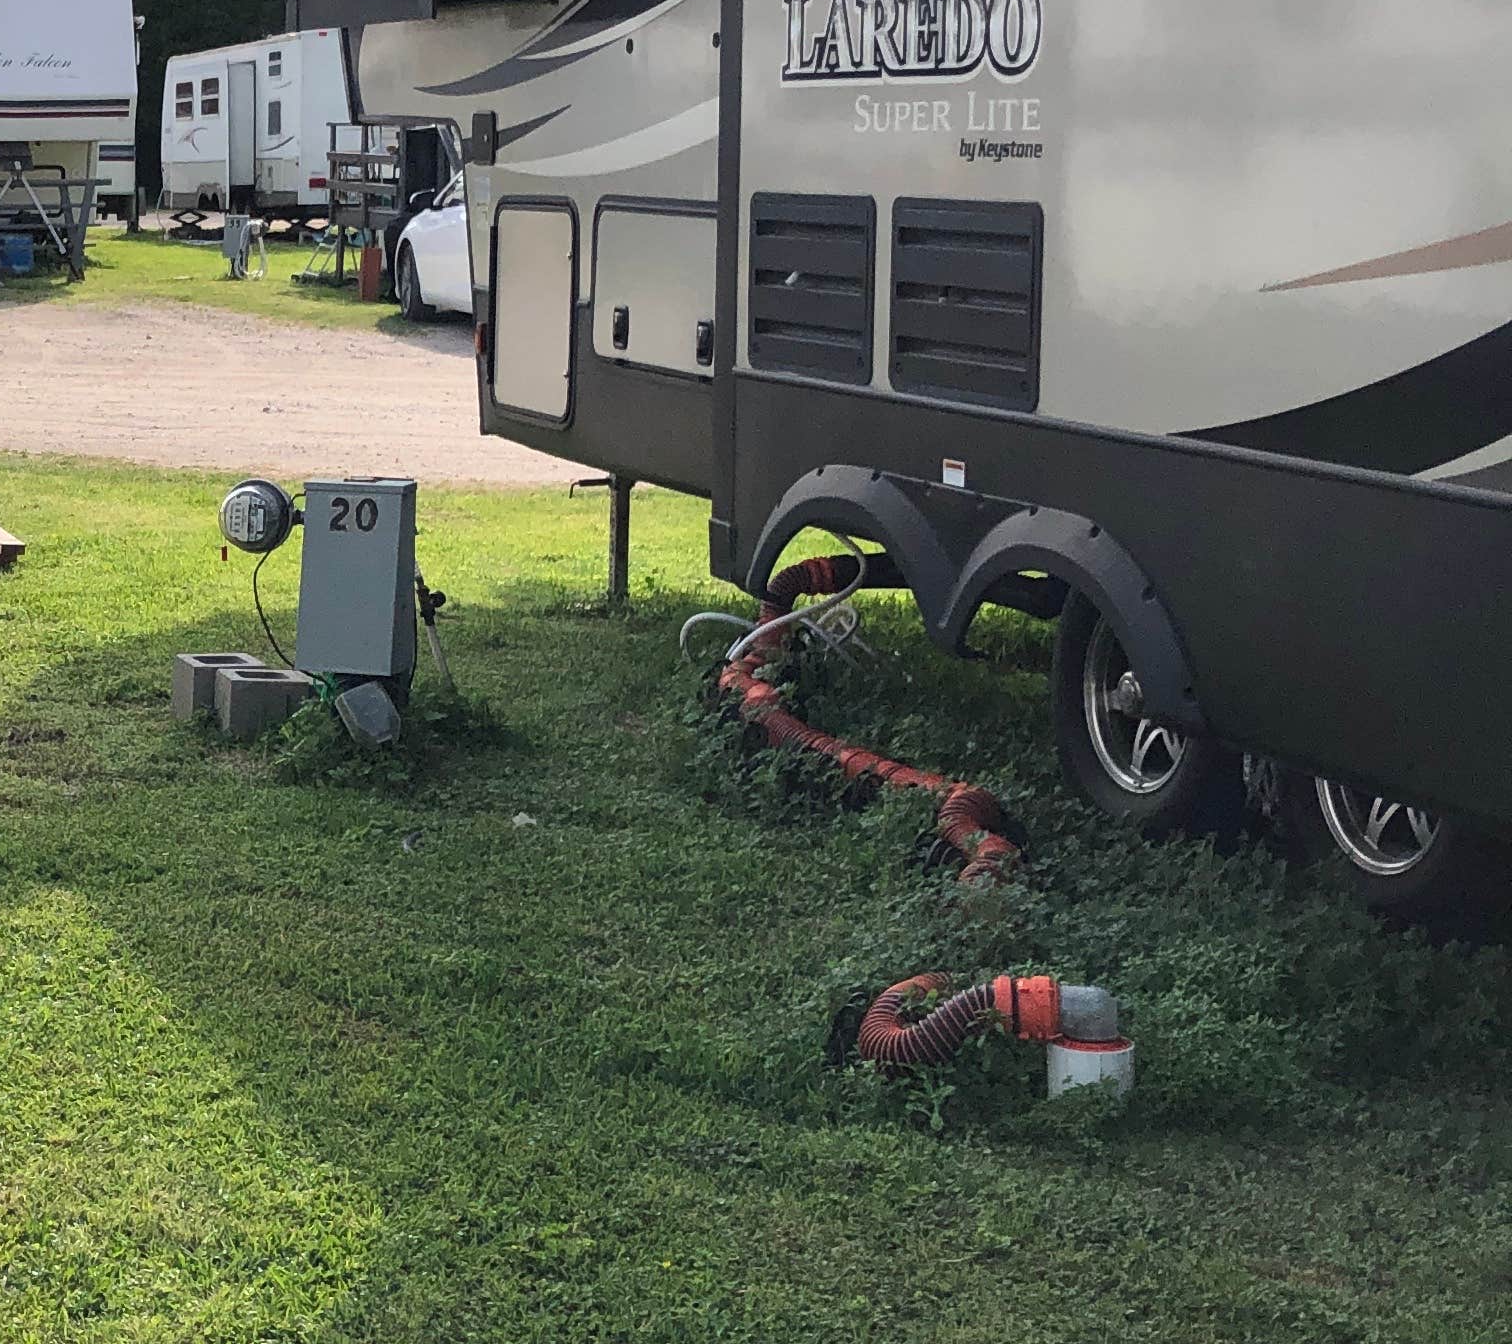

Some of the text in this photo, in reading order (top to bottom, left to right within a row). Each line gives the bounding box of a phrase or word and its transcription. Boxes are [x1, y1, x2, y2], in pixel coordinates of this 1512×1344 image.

[854, 90, 1041, 133] SUPER LITE
[959, 137, 1043, 163] by Keystone
[329, 497, 379, 532] 20
